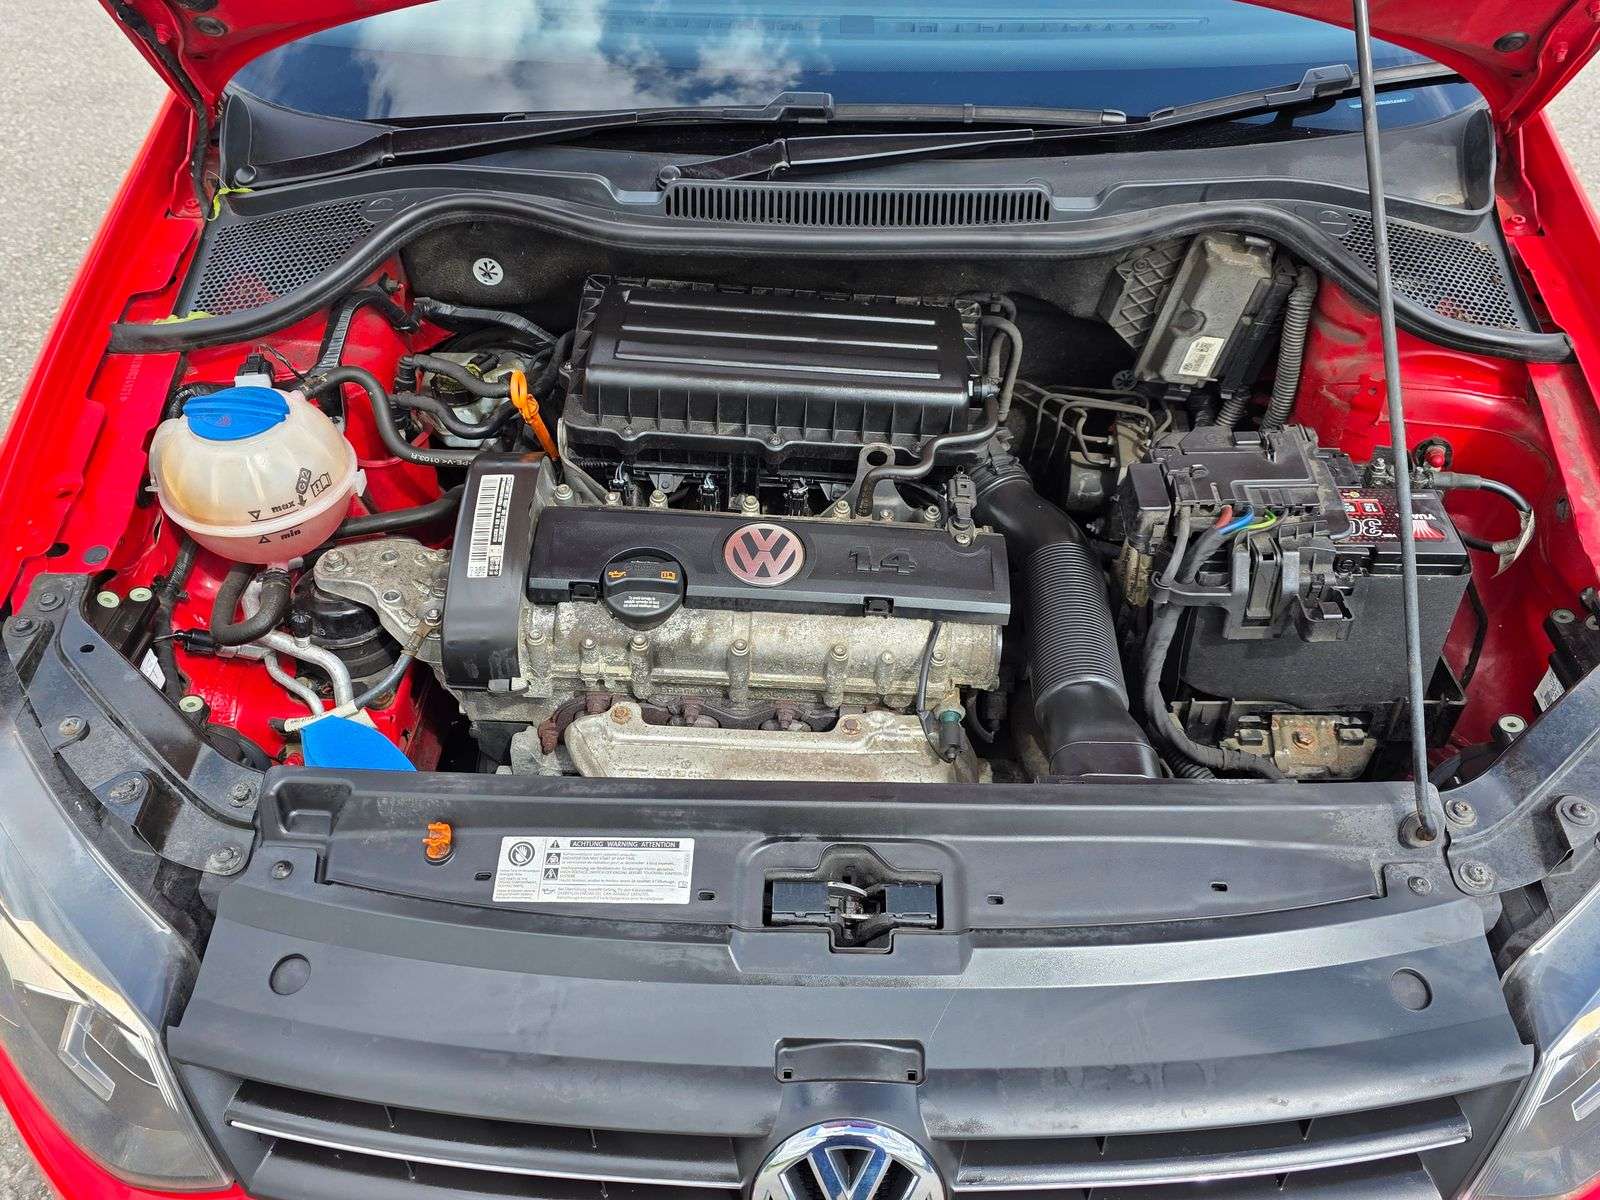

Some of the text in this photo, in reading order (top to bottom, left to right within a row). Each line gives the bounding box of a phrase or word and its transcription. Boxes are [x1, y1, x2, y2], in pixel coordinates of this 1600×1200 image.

[297, 469, 311, 493] G12
[271, 500, 296, 514] max
[280, 528, 302, 541] min
[724, 523, 806, 587] VW
[847, 545, 920, 576] 1.4
[571, 840, 677, 849] ACHTUNG WARNING ATTENTION
